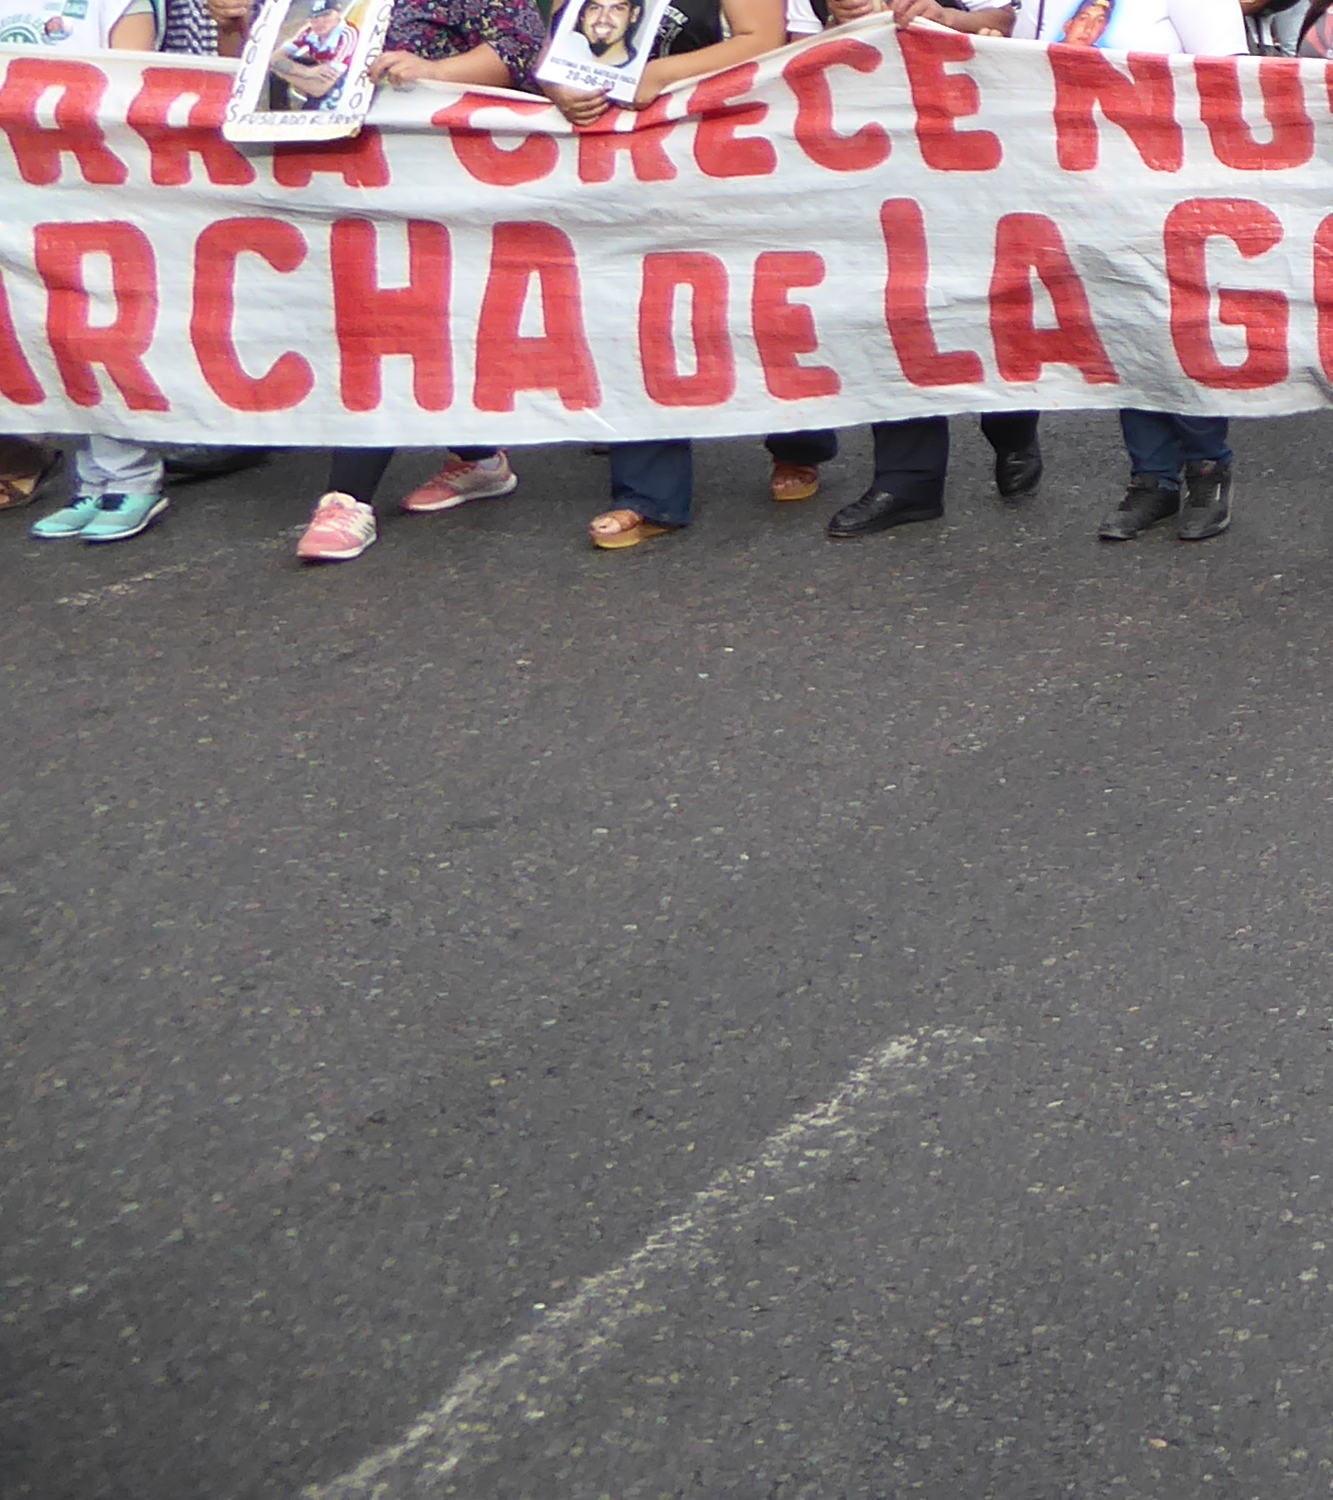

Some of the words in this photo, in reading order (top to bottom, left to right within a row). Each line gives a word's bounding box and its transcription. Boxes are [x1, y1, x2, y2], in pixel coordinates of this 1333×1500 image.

[431, 27, 1003, 187] CRECE
[638, 250, 842, 407] DE
[880, 197, 1120, 388] LA
